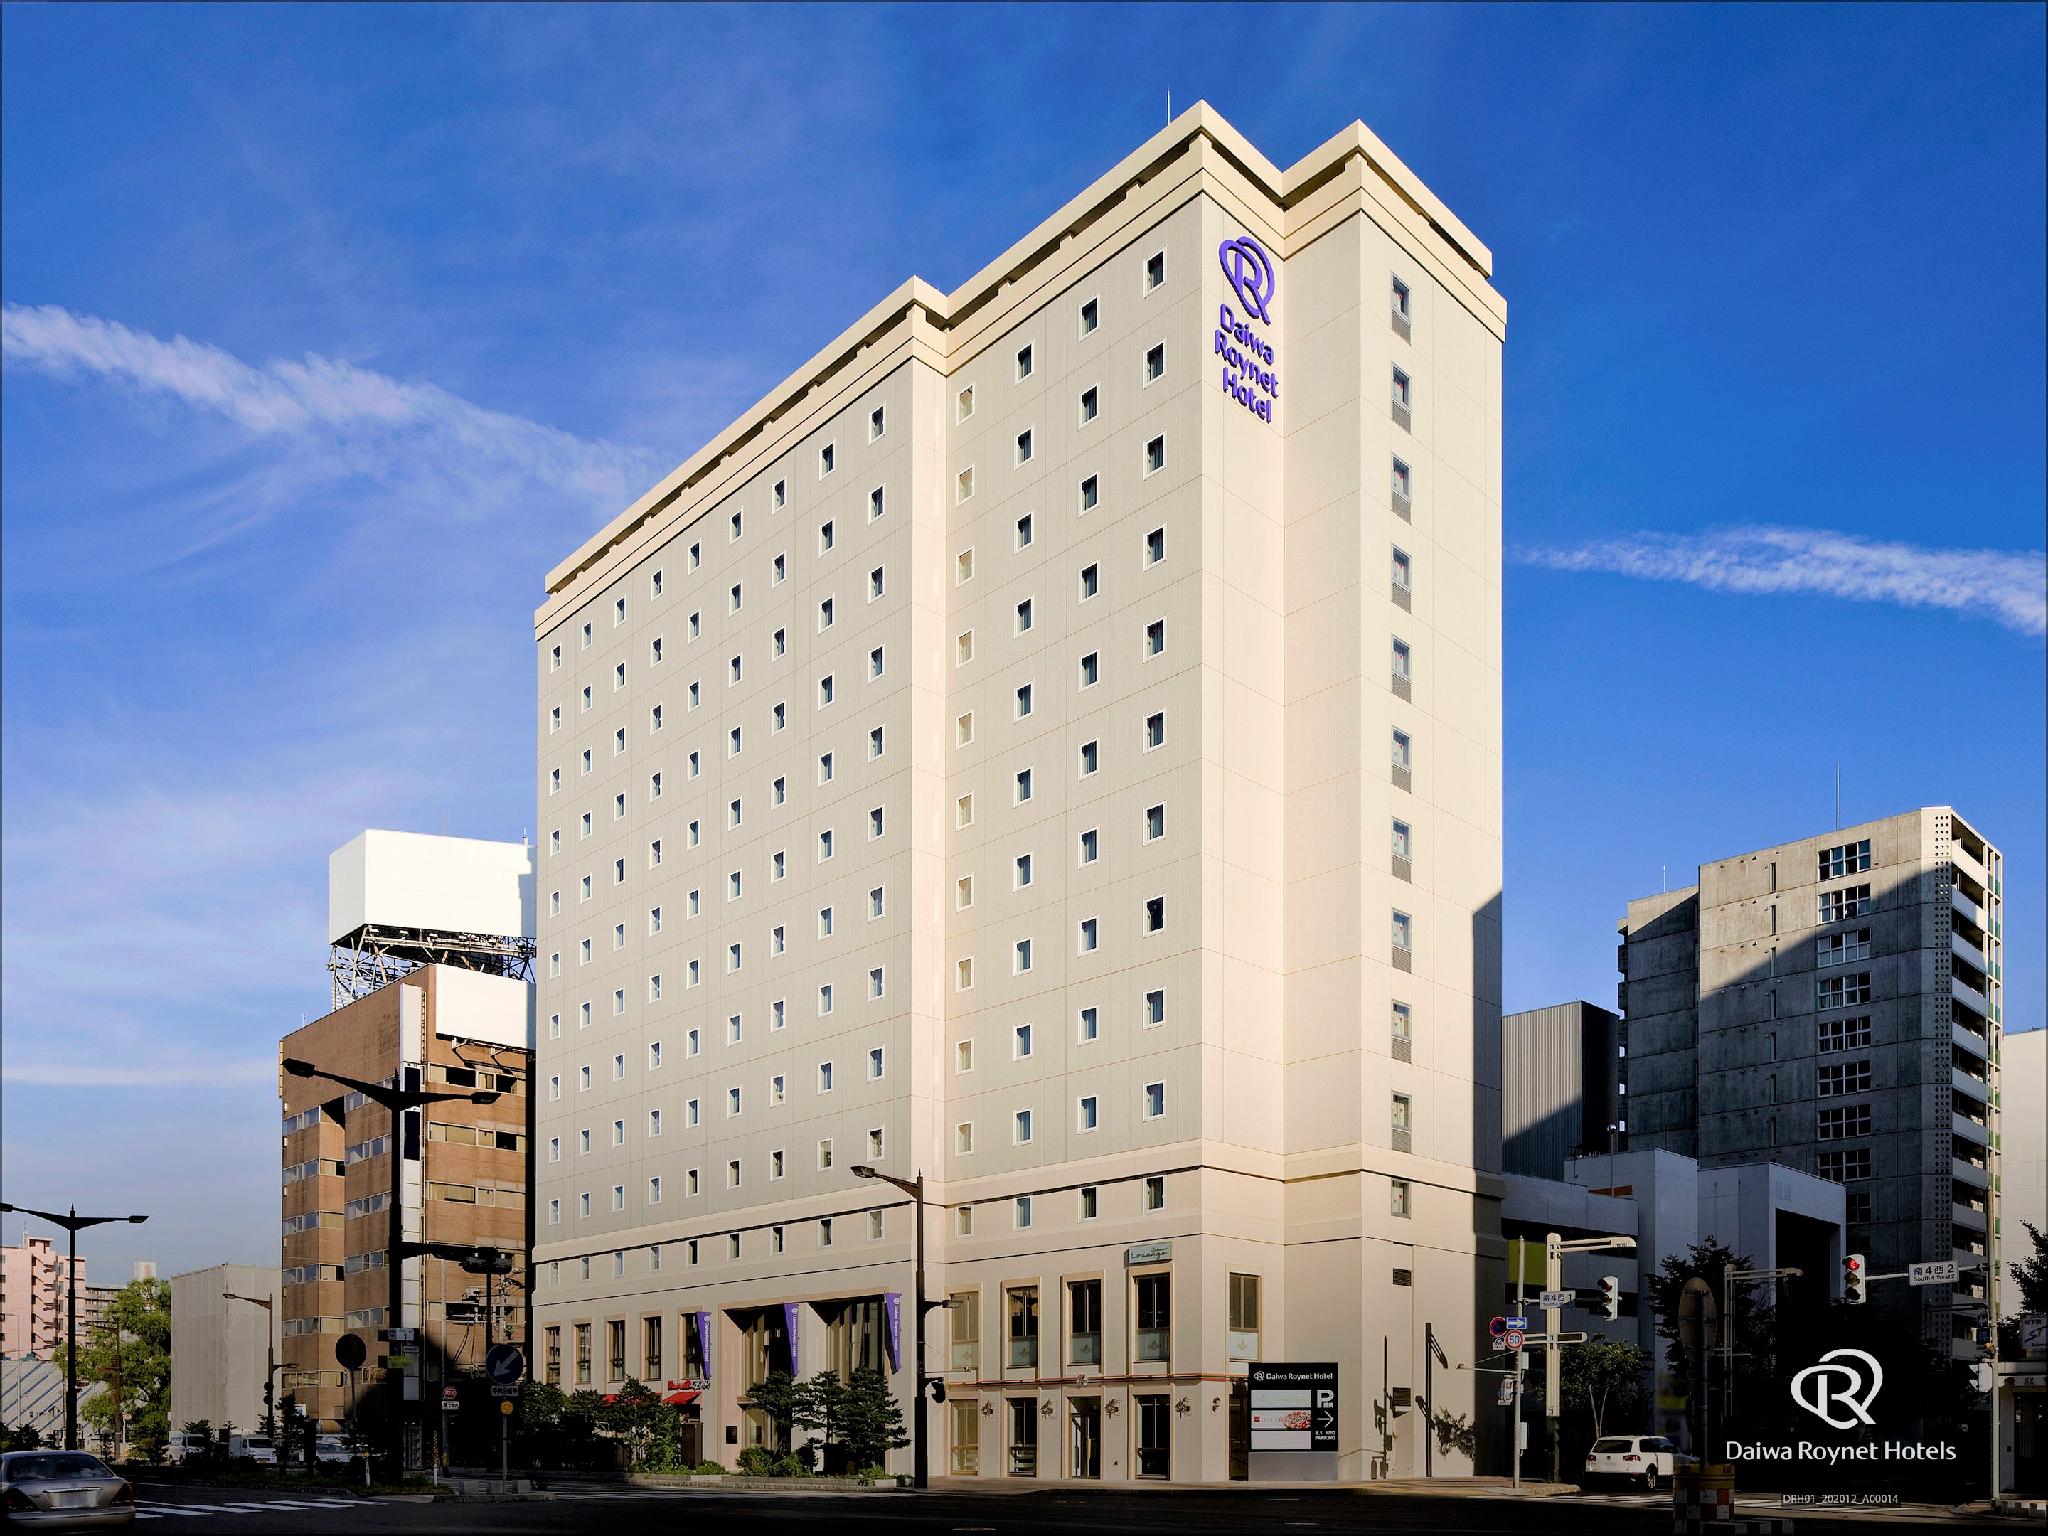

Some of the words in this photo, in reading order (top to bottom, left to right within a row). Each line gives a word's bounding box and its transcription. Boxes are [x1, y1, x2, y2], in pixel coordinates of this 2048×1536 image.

[1220, 304, 1275, 365] Daiwa
[1215, 329, 1279, 398] Roynet
[1222, 367, 1272, 423] Hotel
[1509, 1335, 1520, 1344] 50
[1265, 1372, 1287, 1380] Daiwa
[1288, 1372, 1313, 1381] Roynet
[1314, 1372, 1333, 1380] Hotel
[1316, 1389, 1334, 1408] P
